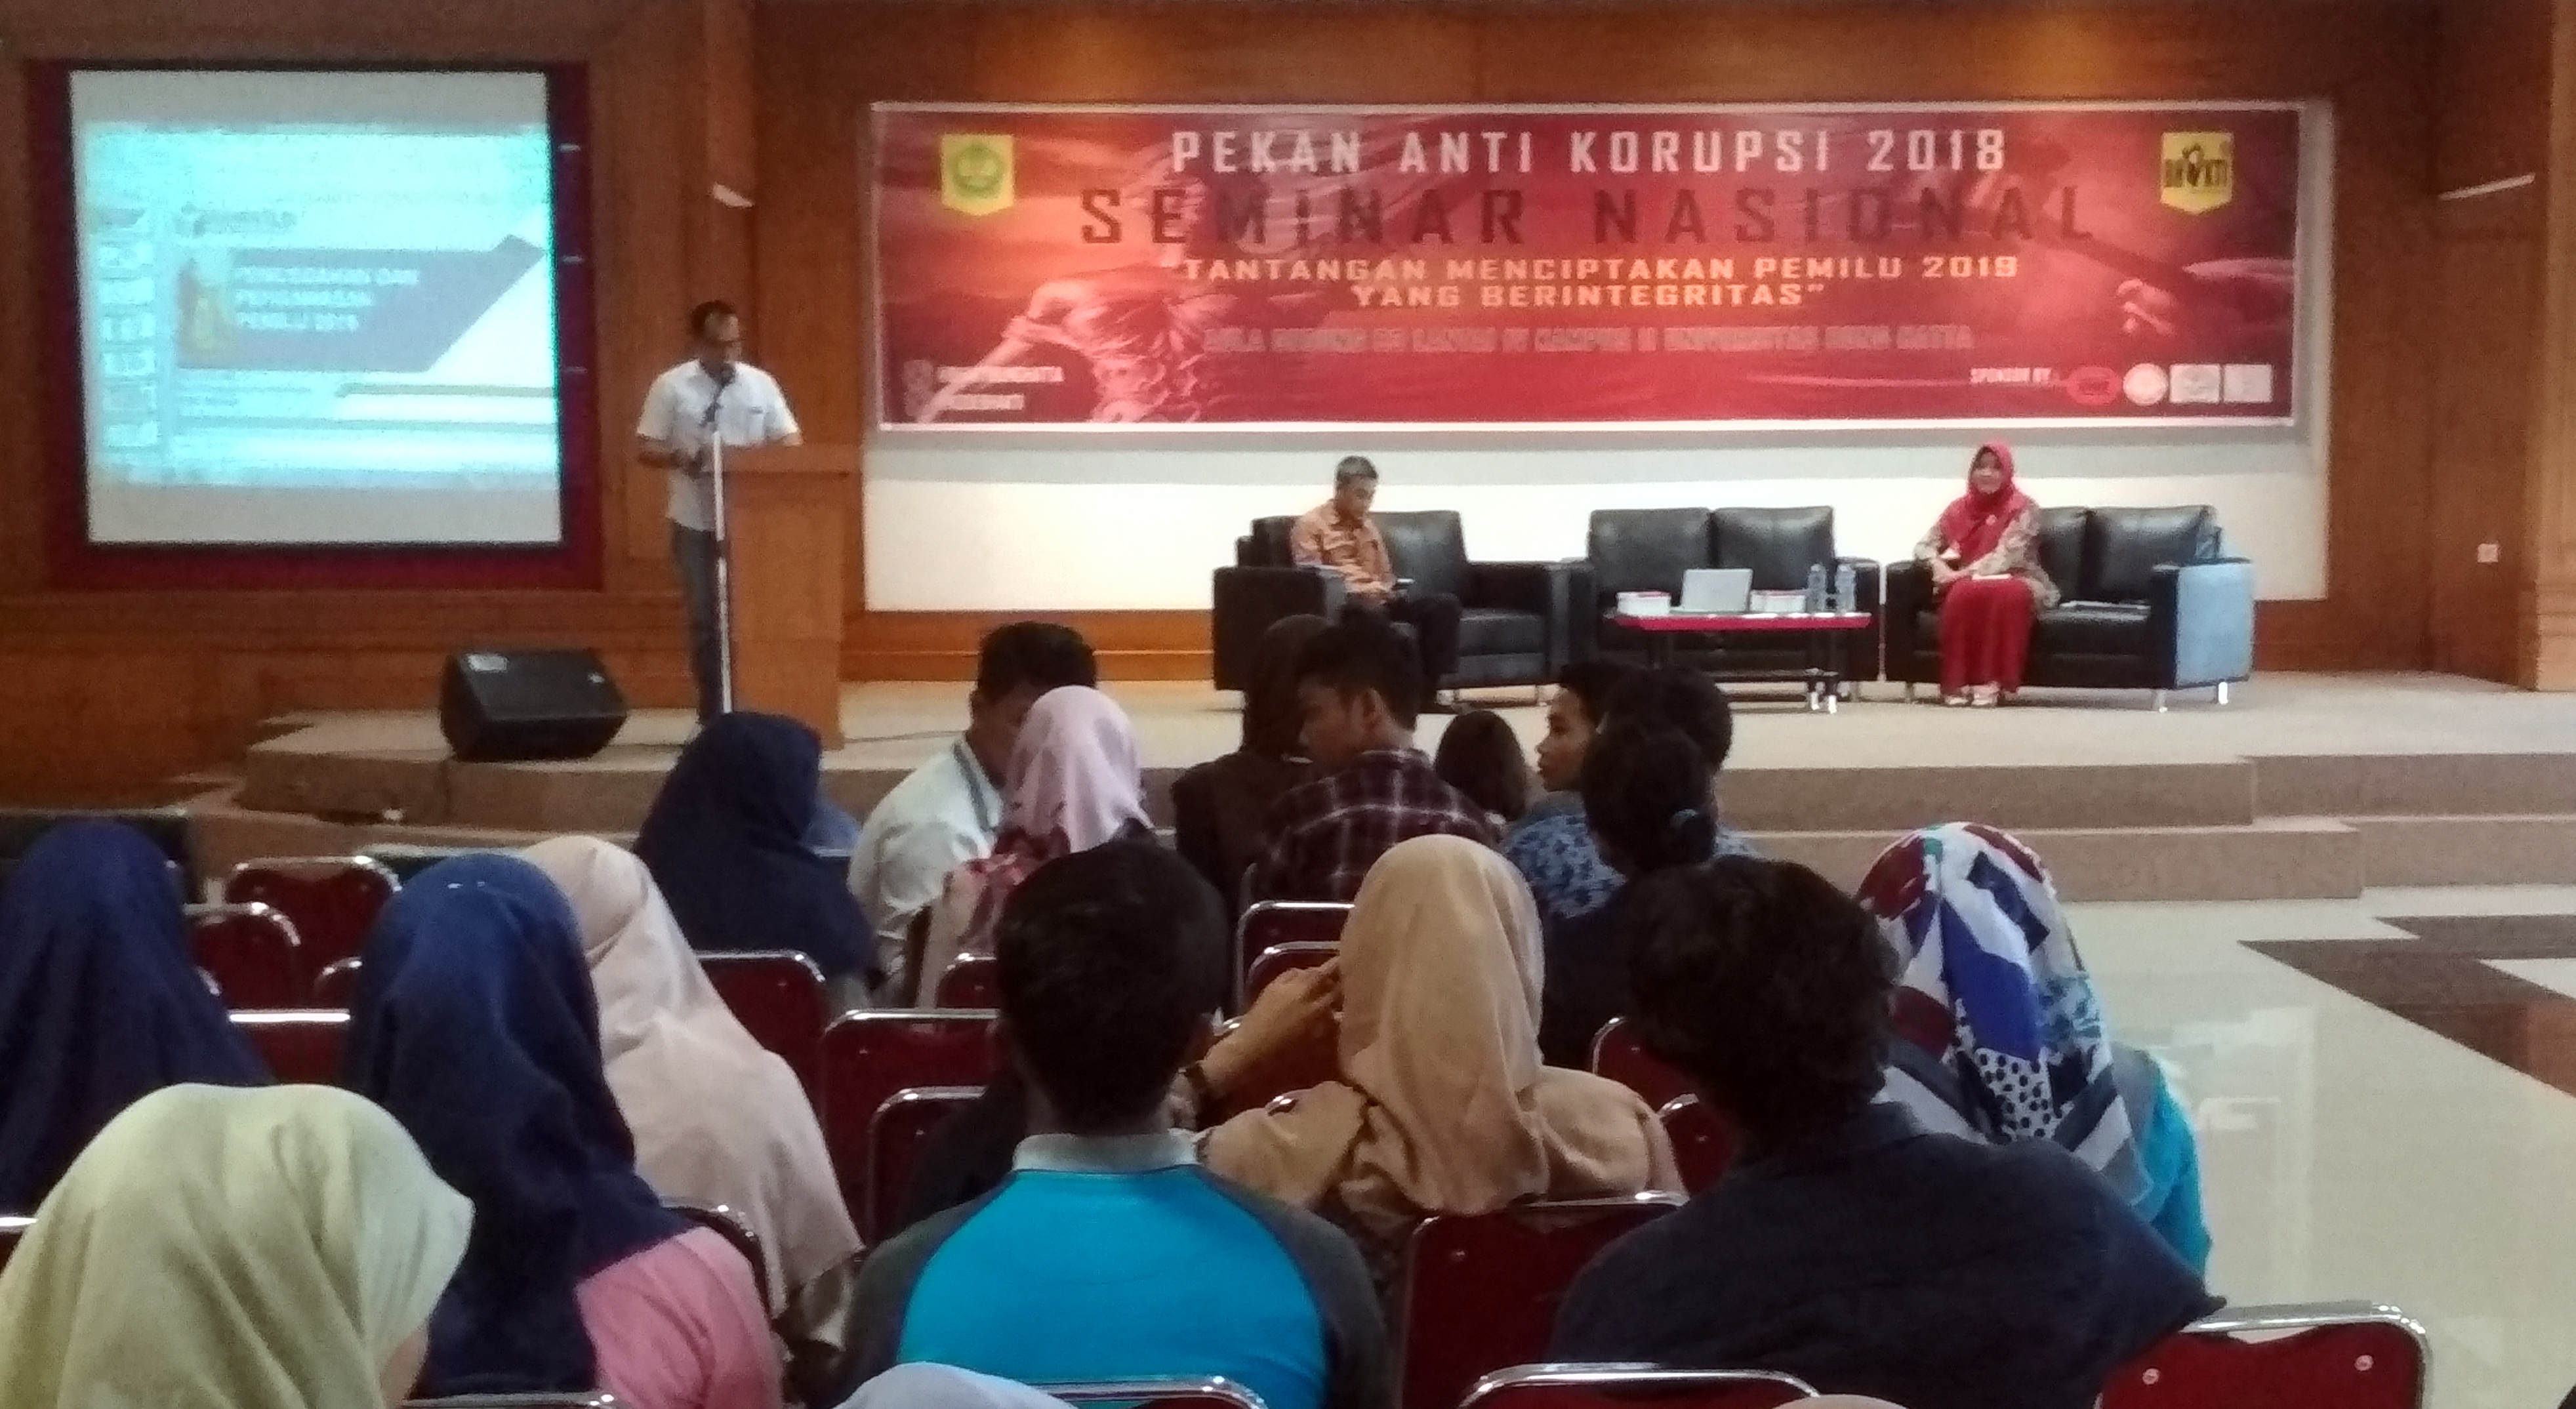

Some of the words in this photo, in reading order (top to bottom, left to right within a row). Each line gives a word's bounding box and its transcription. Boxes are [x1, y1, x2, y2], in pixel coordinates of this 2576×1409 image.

[1172, 131, 1360, 173] PEKAN
[1399, 131, 1532, 173] ANTI
[1570, 130, 1830, 173] KORUPSI
[1867, 129, 2005, 172] 2018
[1080, 188, 1524, 245] SEMINAR
[1593, 187, 2093, 244] NASIONAL
[1183, 259, 1426, 281] TANTANGAN
[1446, 258, 1734, 281] MENCIPTAKAN
[1755, 256, 1903, 279] PEMILU
[1351, 285, 1460, 307] YANG
